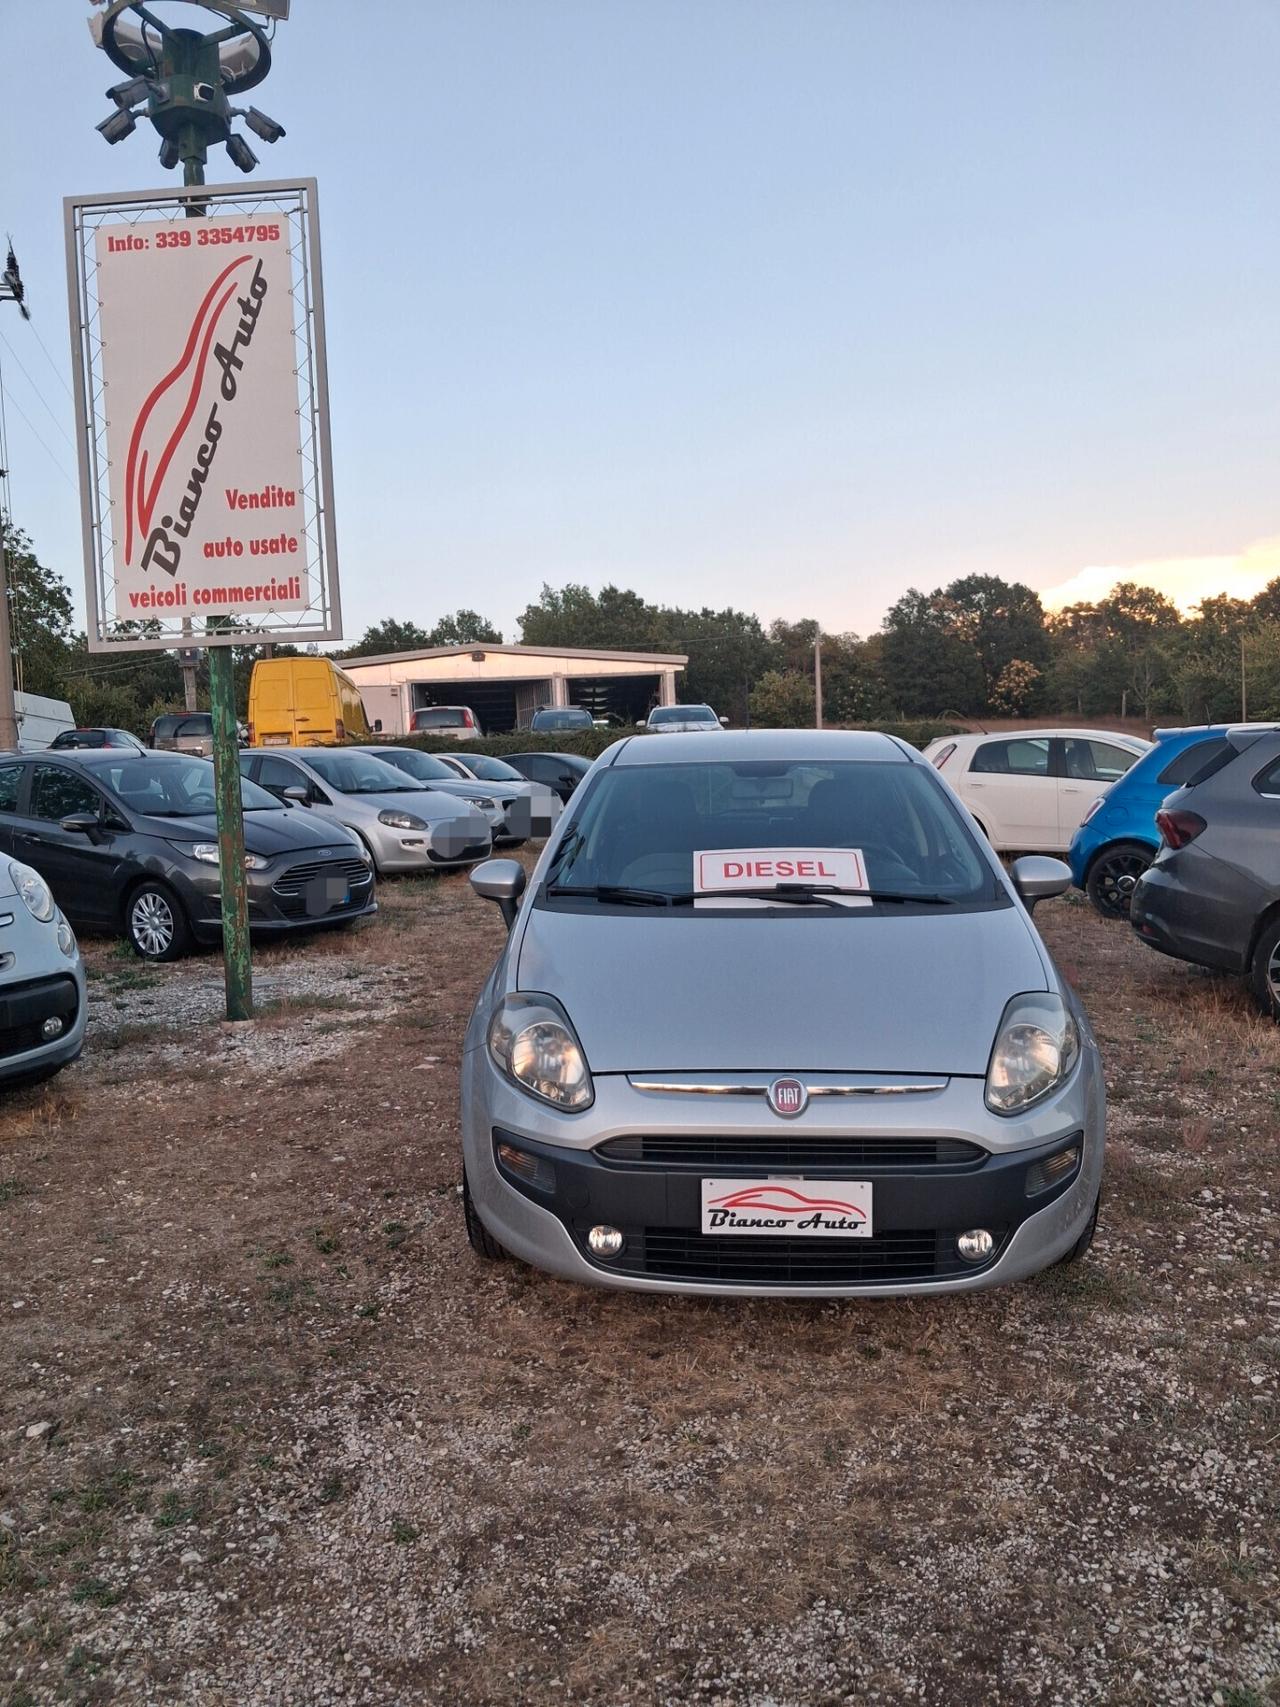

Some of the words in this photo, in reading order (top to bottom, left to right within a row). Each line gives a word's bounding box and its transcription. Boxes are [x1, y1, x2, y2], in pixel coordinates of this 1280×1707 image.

[108, 234, 150, 253] Info:
[155, 231, 191, 249] 339
[197, 224, 281, 246] 3354795
[140, 402, 223, 577] Bianco
[213, 258, 269, 401] Auto
[225, 486, 296, 511] Vendita
[203, 537, 244, 559] auto
[250, 533, 299, 557] usate
[128, 583, 187, 609] veicoli
[192, 576, 301, 606] commerciali
[723, 861, 837, 878] DIESEL
[778, 1088, 799, 1104] FIAT
[707, 1208, 794, 1228] Bianco
[797, 1213, 866, 1230] Auto
